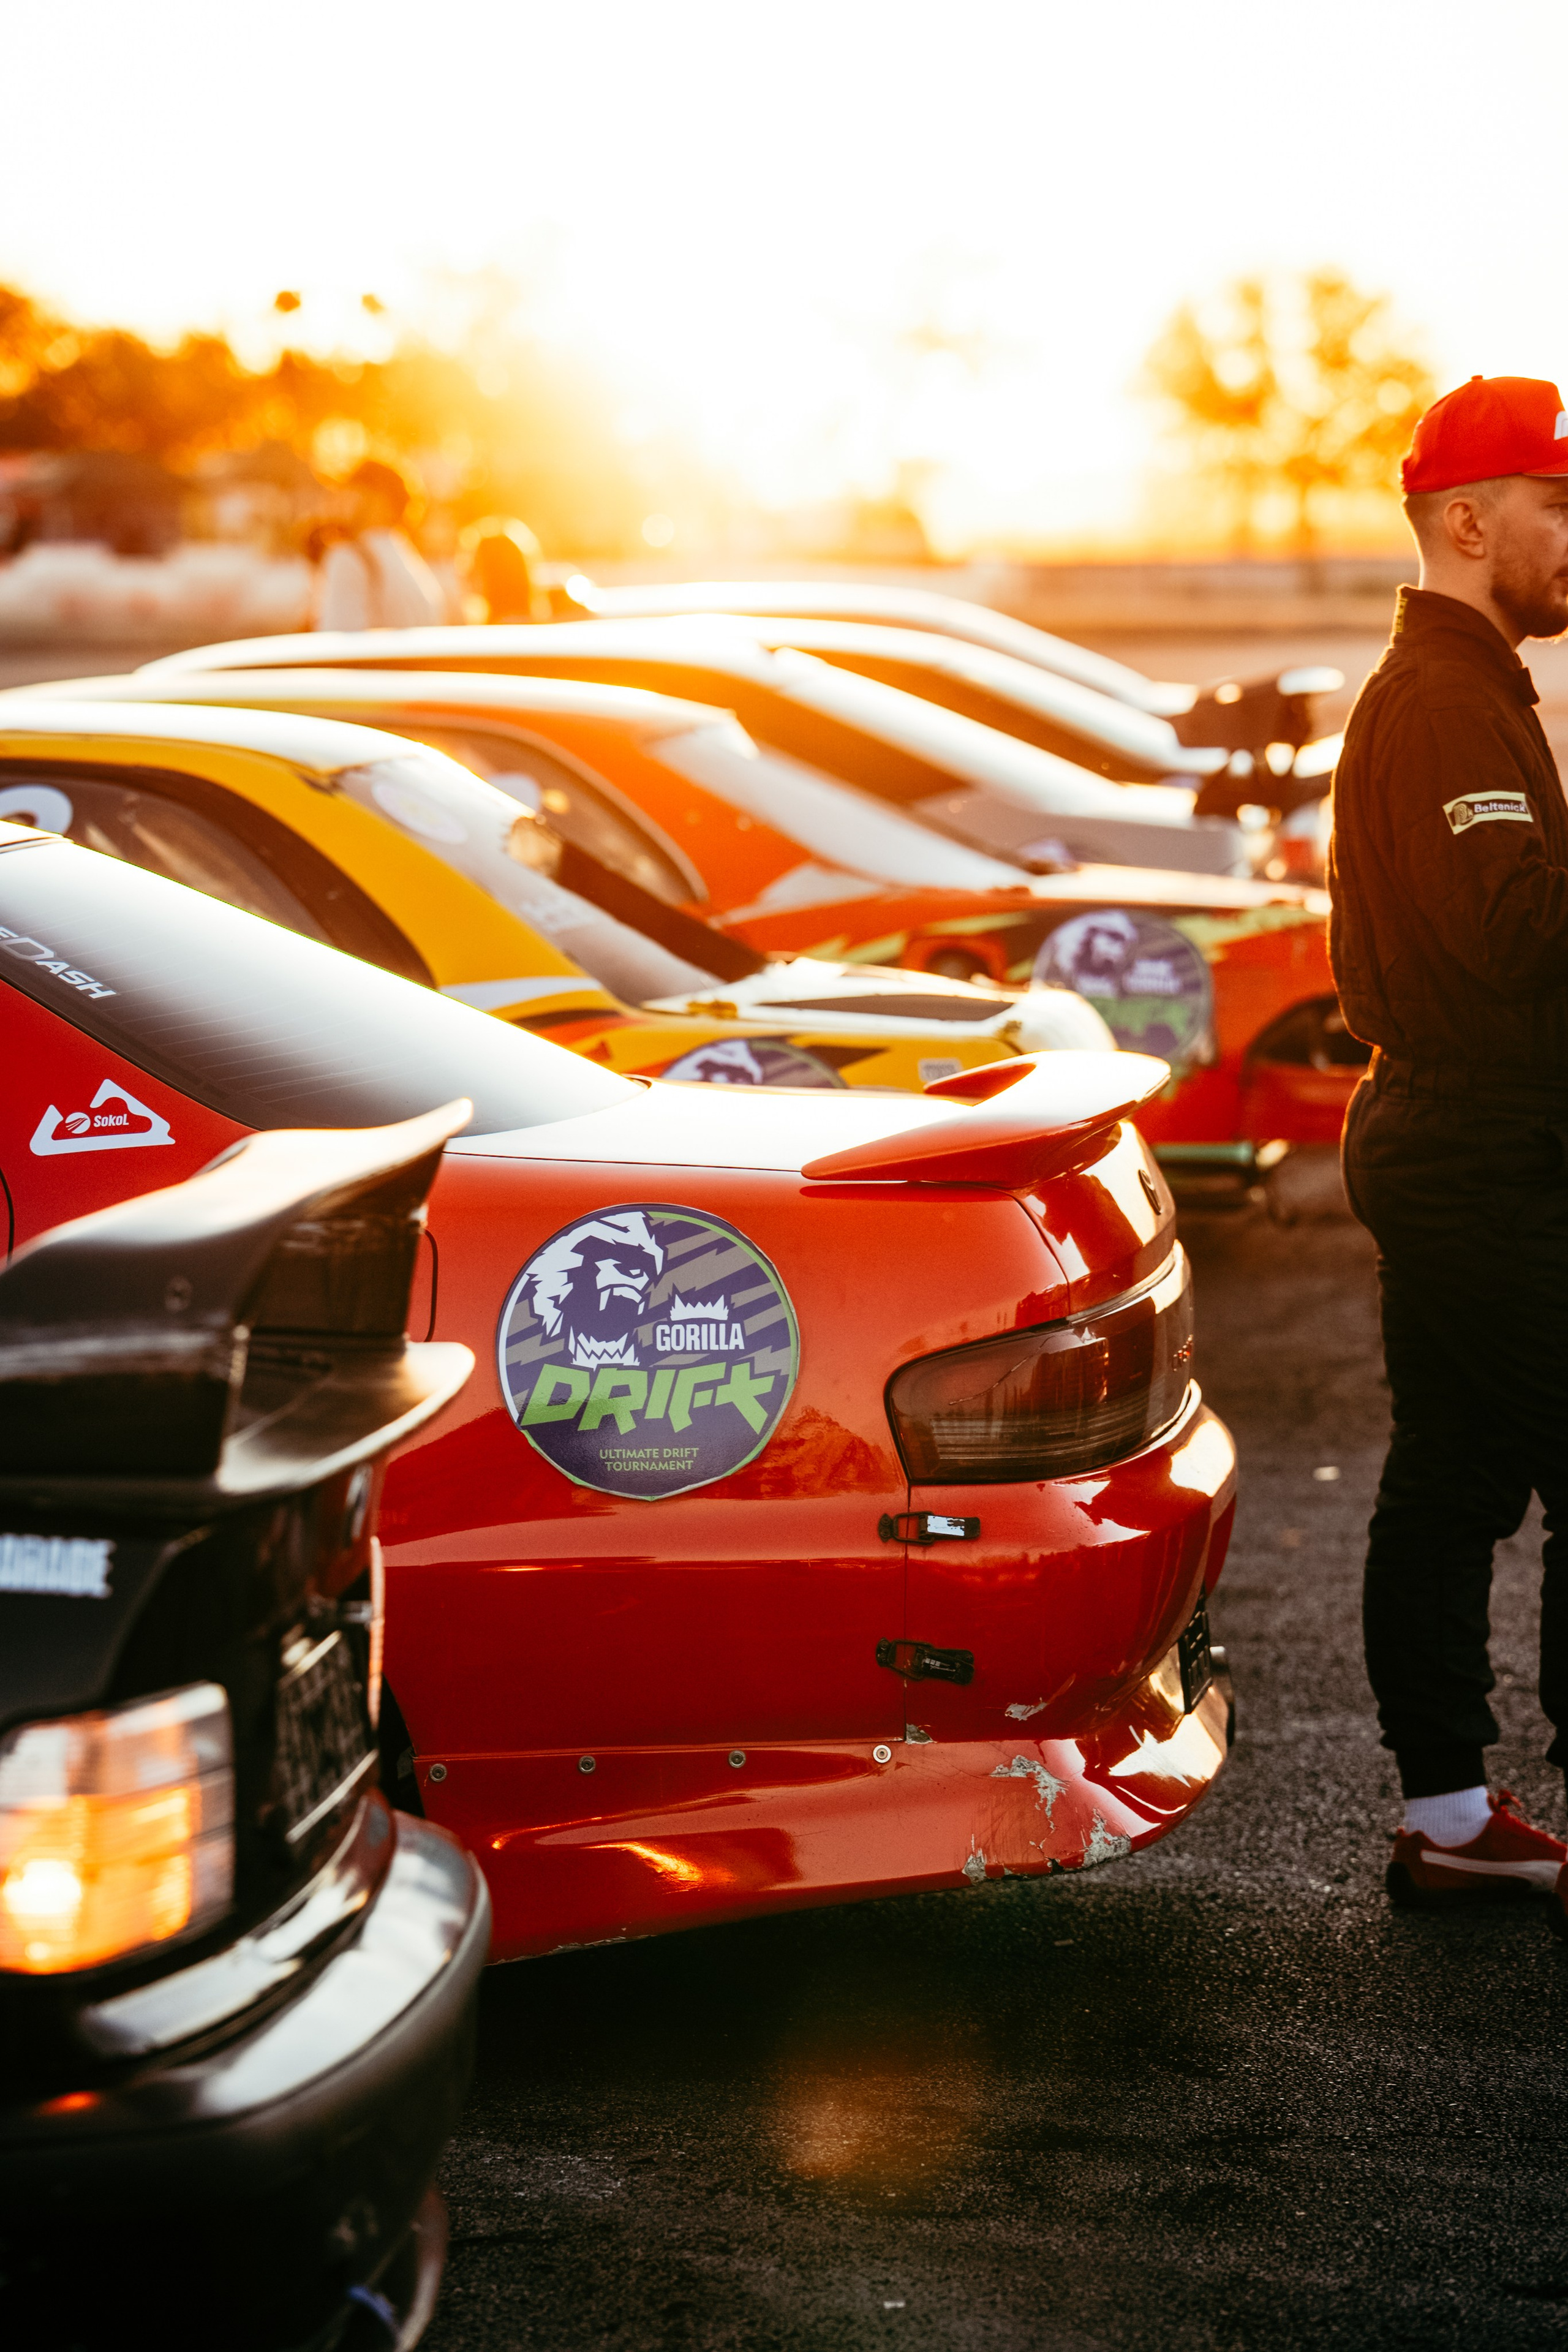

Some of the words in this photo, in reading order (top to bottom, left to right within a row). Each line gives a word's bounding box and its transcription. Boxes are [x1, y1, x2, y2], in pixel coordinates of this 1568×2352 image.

[1474, 802, 1526, 813] Beltenick
[656, 1323, 745, 1351] GORILLA
[520, 1362, 775, 1435] DRIFT
[599, 1449, 659, 1459] ULTIMATE
[663, 1447, 699, 1458] DRIFT
[605, 1460, 694, 1471] TOURNAMENT
